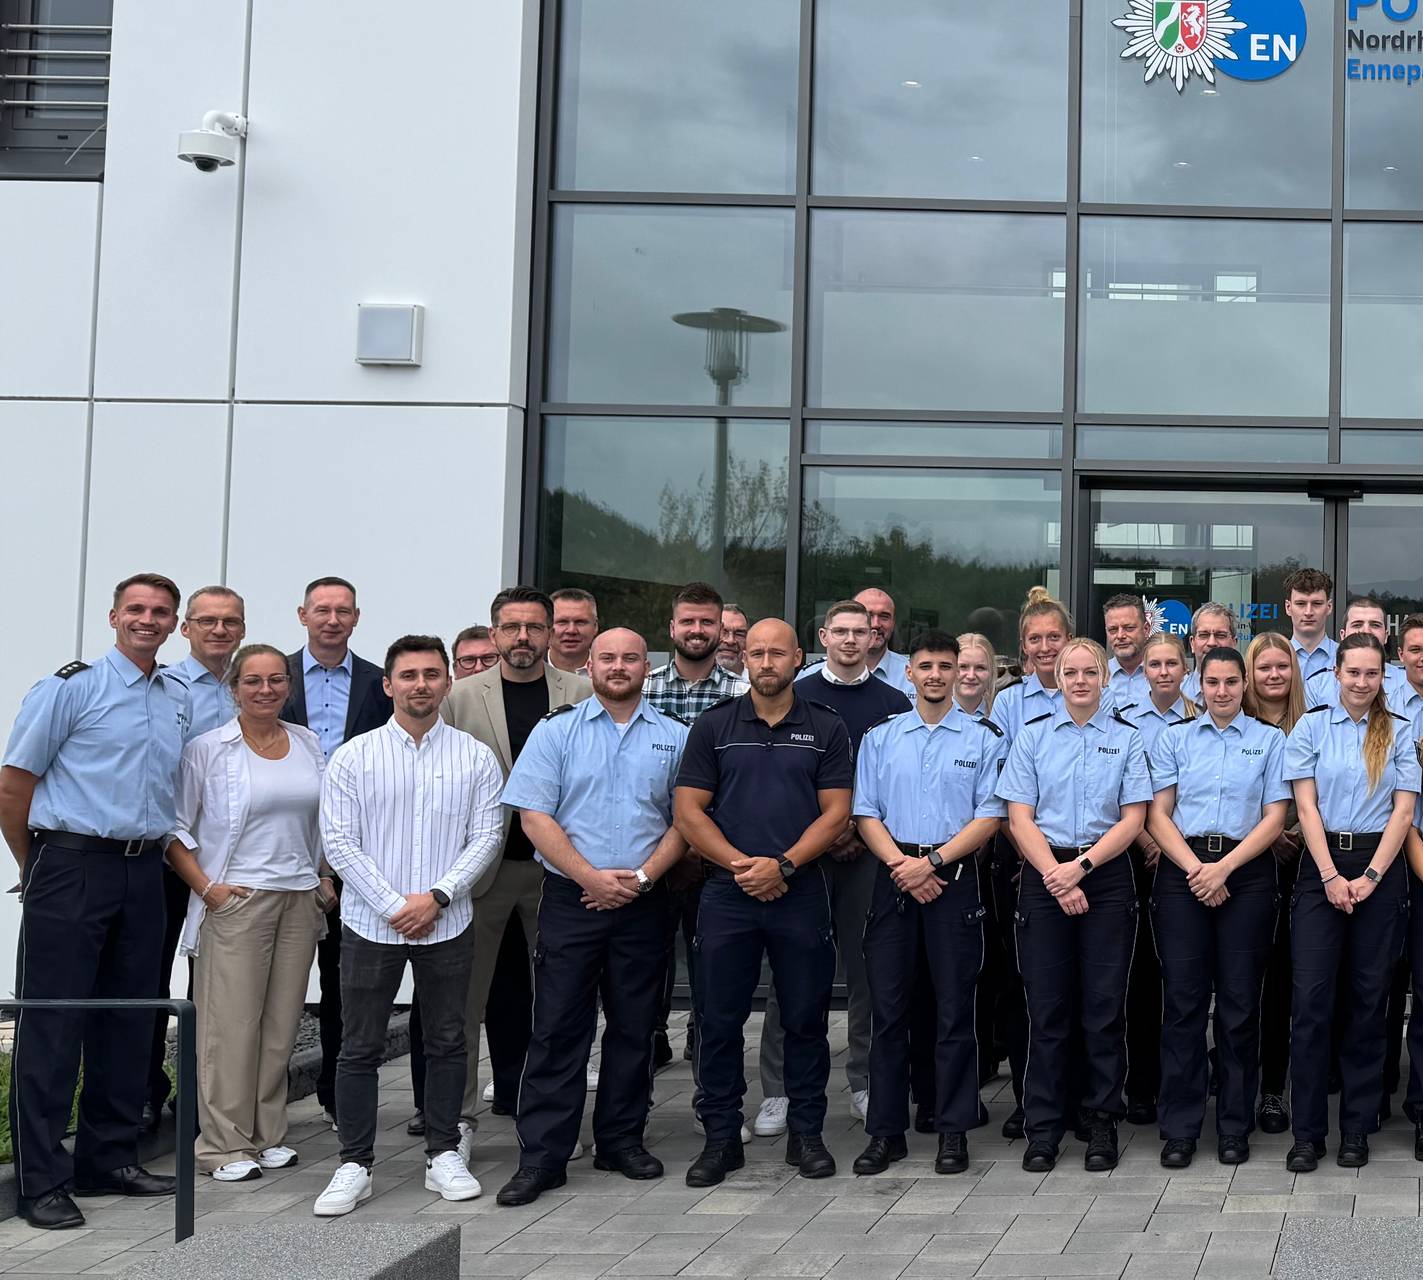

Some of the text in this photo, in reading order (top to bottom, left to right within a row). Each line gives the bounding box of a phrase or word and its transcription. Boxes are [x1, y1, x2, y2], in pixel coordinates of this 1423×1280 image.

[1250, 33, 1297, 62] EN
[1169, 623, 1189, 635] EN
[790, 733, 815, 742] POLIZEI
[652, 743, 676, 752] POLIZEI
[1098, 746, 1120, 755] POLIZEI
[1241, 748, 1264, 756] POLIZEI
[954, 759, 977, 769] POLIZEI
